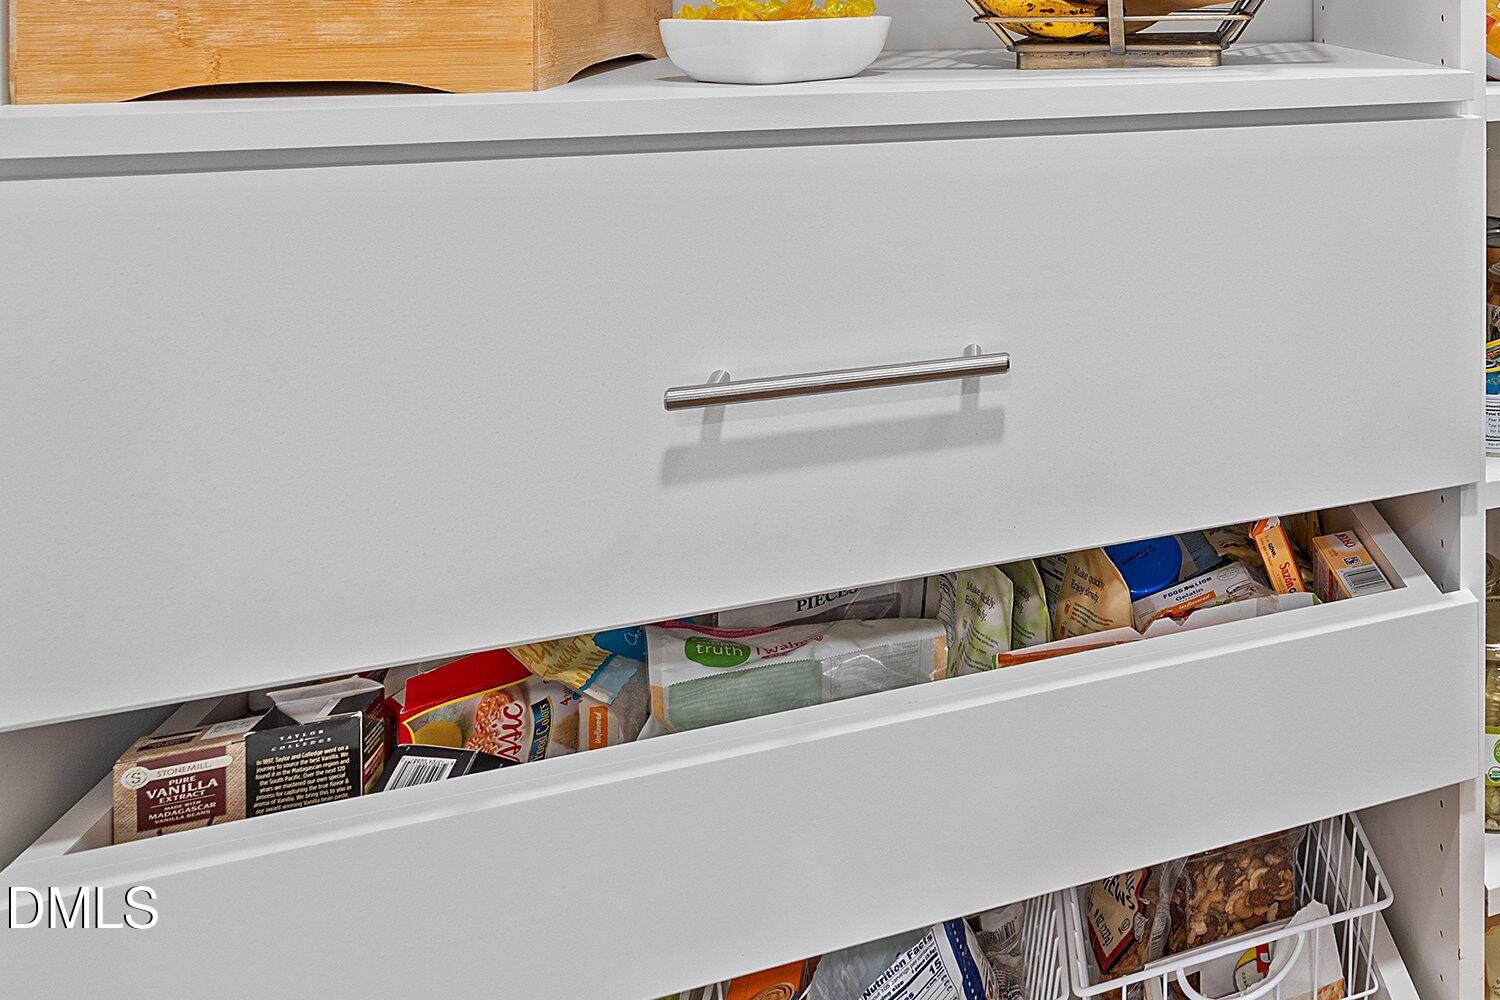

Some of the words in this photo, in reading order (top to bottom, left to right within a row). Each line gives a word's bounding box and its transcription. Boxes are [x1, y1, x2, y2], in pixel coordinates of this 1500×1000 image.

[1176, 587, 1204, 601] Gelatin
[696, 641, 743, 657] truth
[280, 730, 323, 741] TAYLOR
[271, 737, 331, 752] COLLEDGE
[157, 763, 208, 778] STONEMILL
[169, 776, 197, 785] PURE
[146, 778, 219, 800] VANILLA
[159, 789, 205, 804] EXTRACT
[148, 802, 217, 820] MADAGASCAR
[164, 803, 180, 811] MADE
[154, 816, 185, 825] VANILLA
[187, 810, 211, 820] BEANS
[863, 959, 906, 999] Nutrition
[907, 933, 934, 959] Facts
